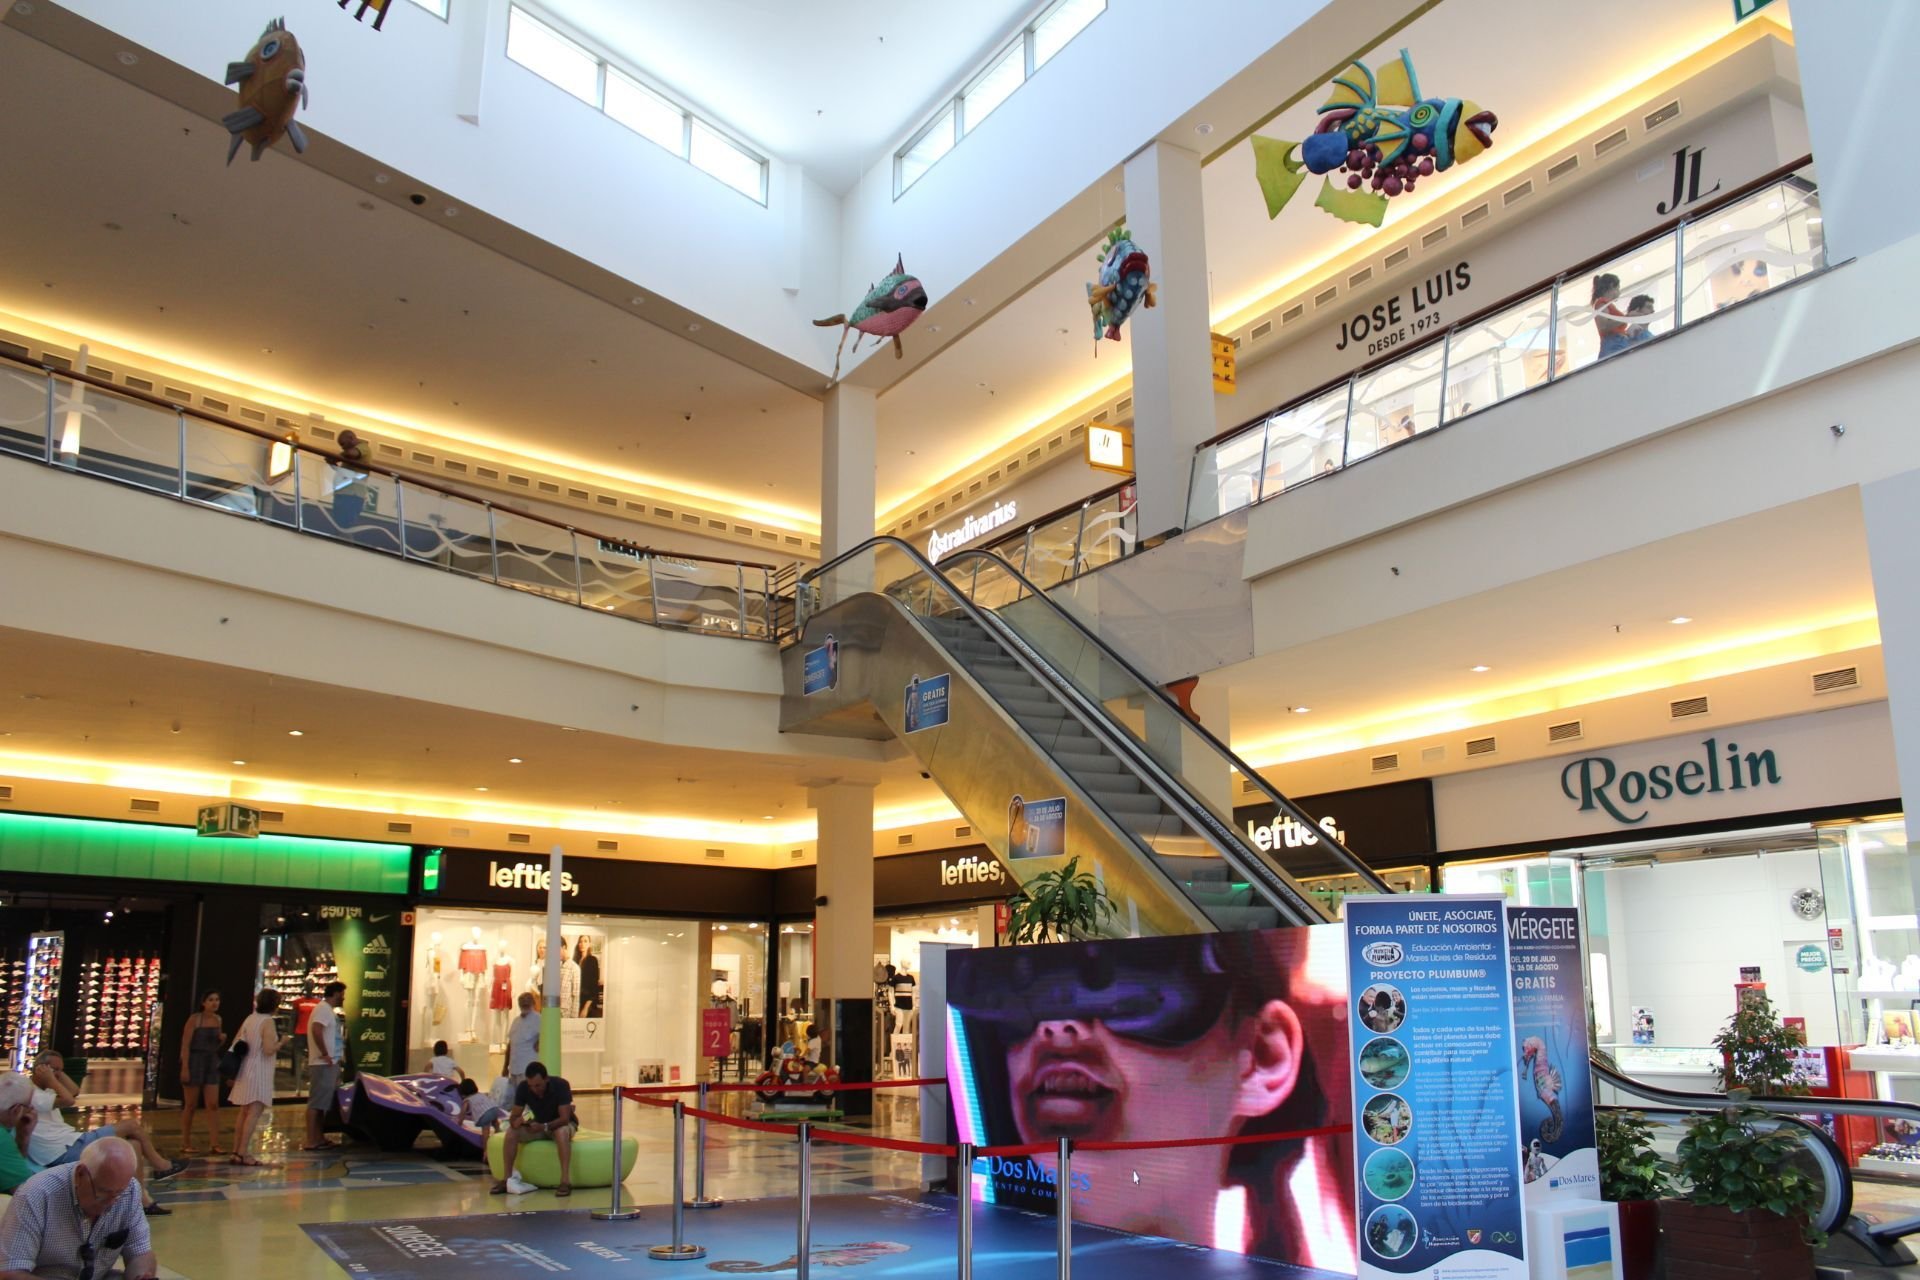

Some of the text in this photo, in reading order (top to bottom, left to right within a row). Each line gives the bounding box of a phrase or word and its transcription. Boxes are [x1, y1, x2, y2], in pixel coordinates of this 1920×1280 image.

[1656, 145, 1721, 215] JL
[1335, 261, 1472, 351] JOSE LUIS
[1367, 311, 1441, 356] DESDE 1973
[922, 687, 945, 702] GRATIS
[1560, 737, 1782, 825] Roselin
[941, 855, 1006, 886] lefties,
[1408, 910, 1497, 922] ÚNETE, ASÓCIATE,
[1355, 923, 1498, 936] FORMA PARTE DE NOSOTROS
[1507, 911, 1576, 940] MÉRGETE
[1411, 943, 1492, 952] Educación Ambiental
[1406, 952, 1497, 962] Mares Libres de Residuos
[1539, 955, 1557, 963] JULIO
[1370, 968, 1487, 980] PROYECTO PLUMBUM®
[1535, 963, 1559, 971] AGOSTO
[1515, 976, 1556, 990] GRATIS
[361, 1007, 386, 1018] FILA
[586, 1021, 597, 1039] 9
[711, 1030, 721, 1048] 2
[990, 1155, 1092, 1192] Dos Maes
[1559, 1173, 1596, 1186] Dos Mares
